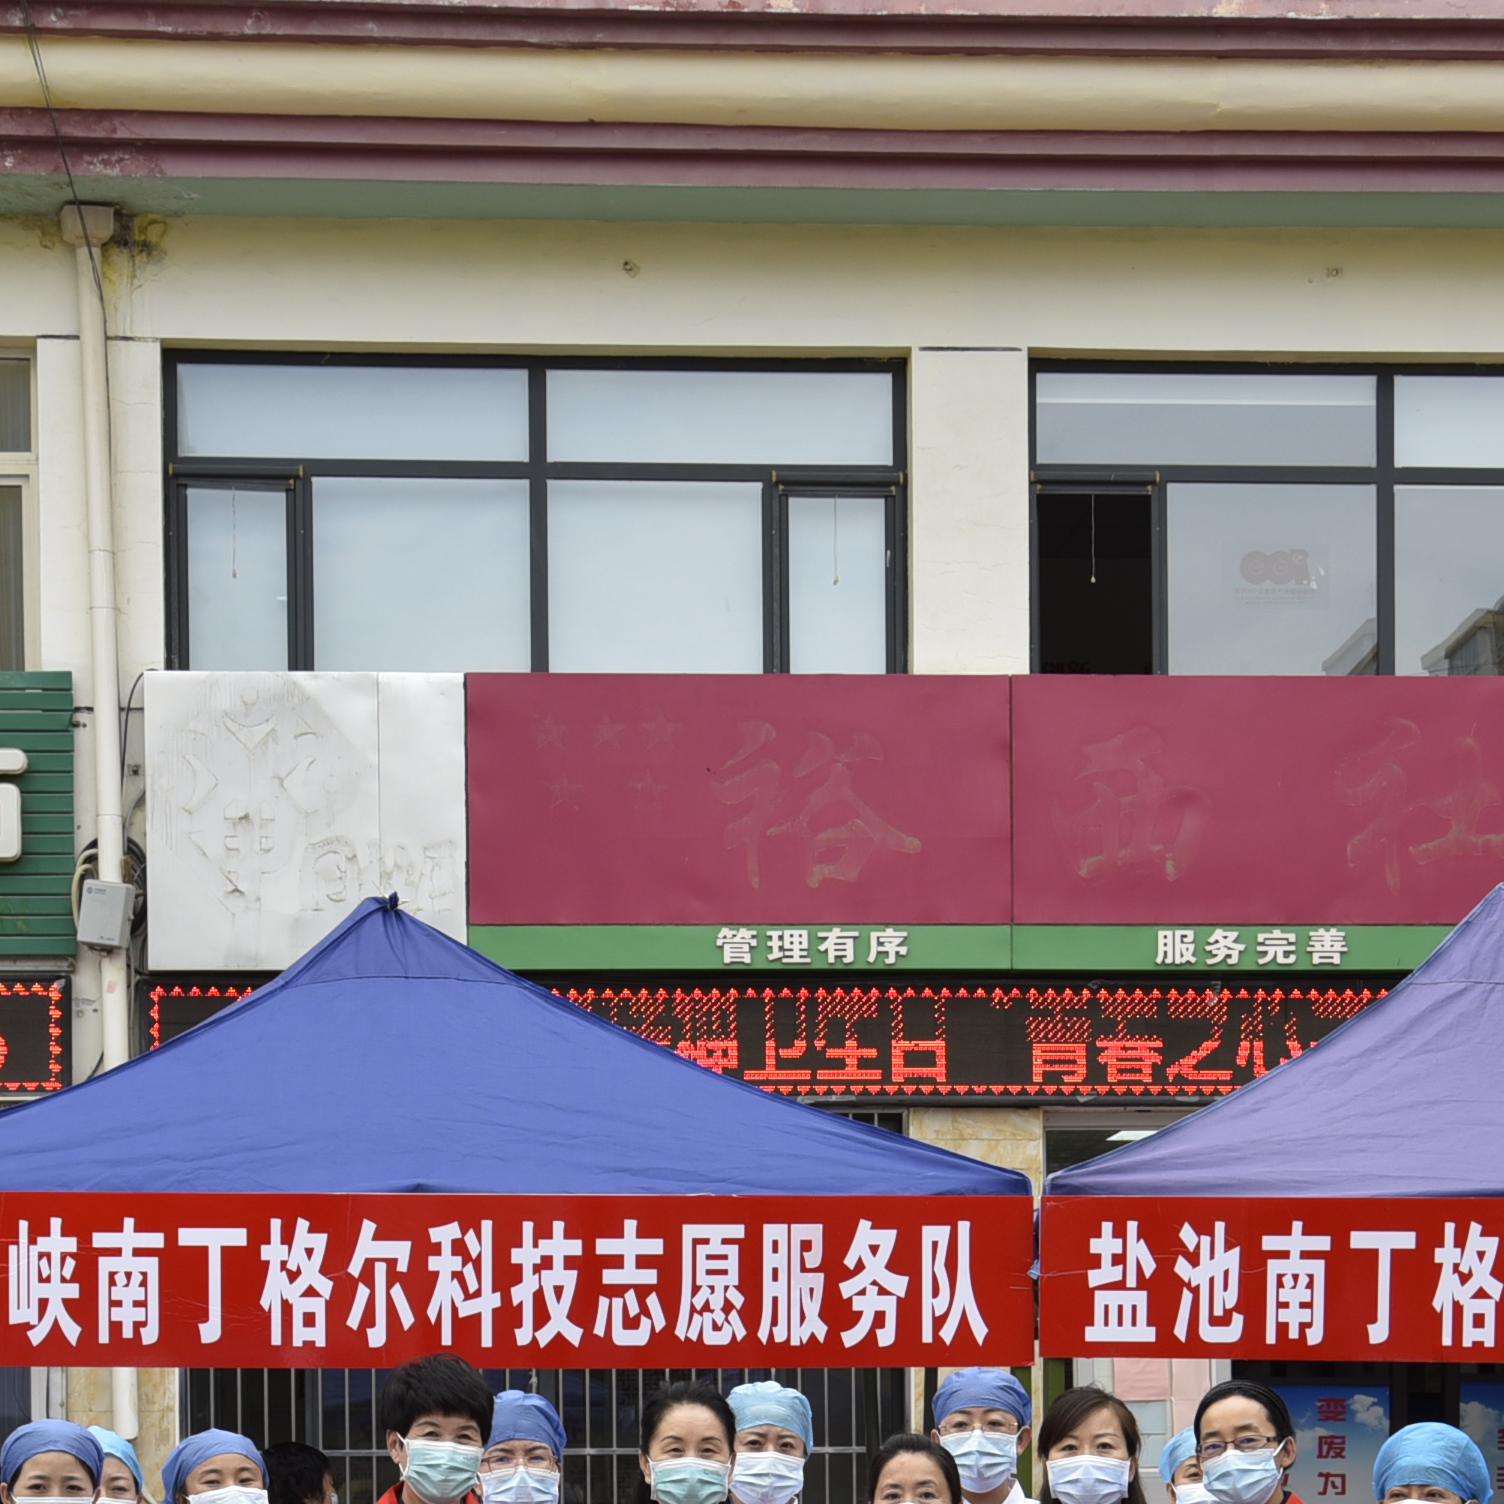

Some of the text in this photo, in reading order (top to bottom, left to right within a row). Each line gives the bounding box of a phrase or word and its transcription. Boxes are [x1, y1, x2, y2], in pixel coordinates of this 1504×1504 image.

[715, 927, 910, 965] 管理有序
[1155, 927, 1350, 965] 服务完善
